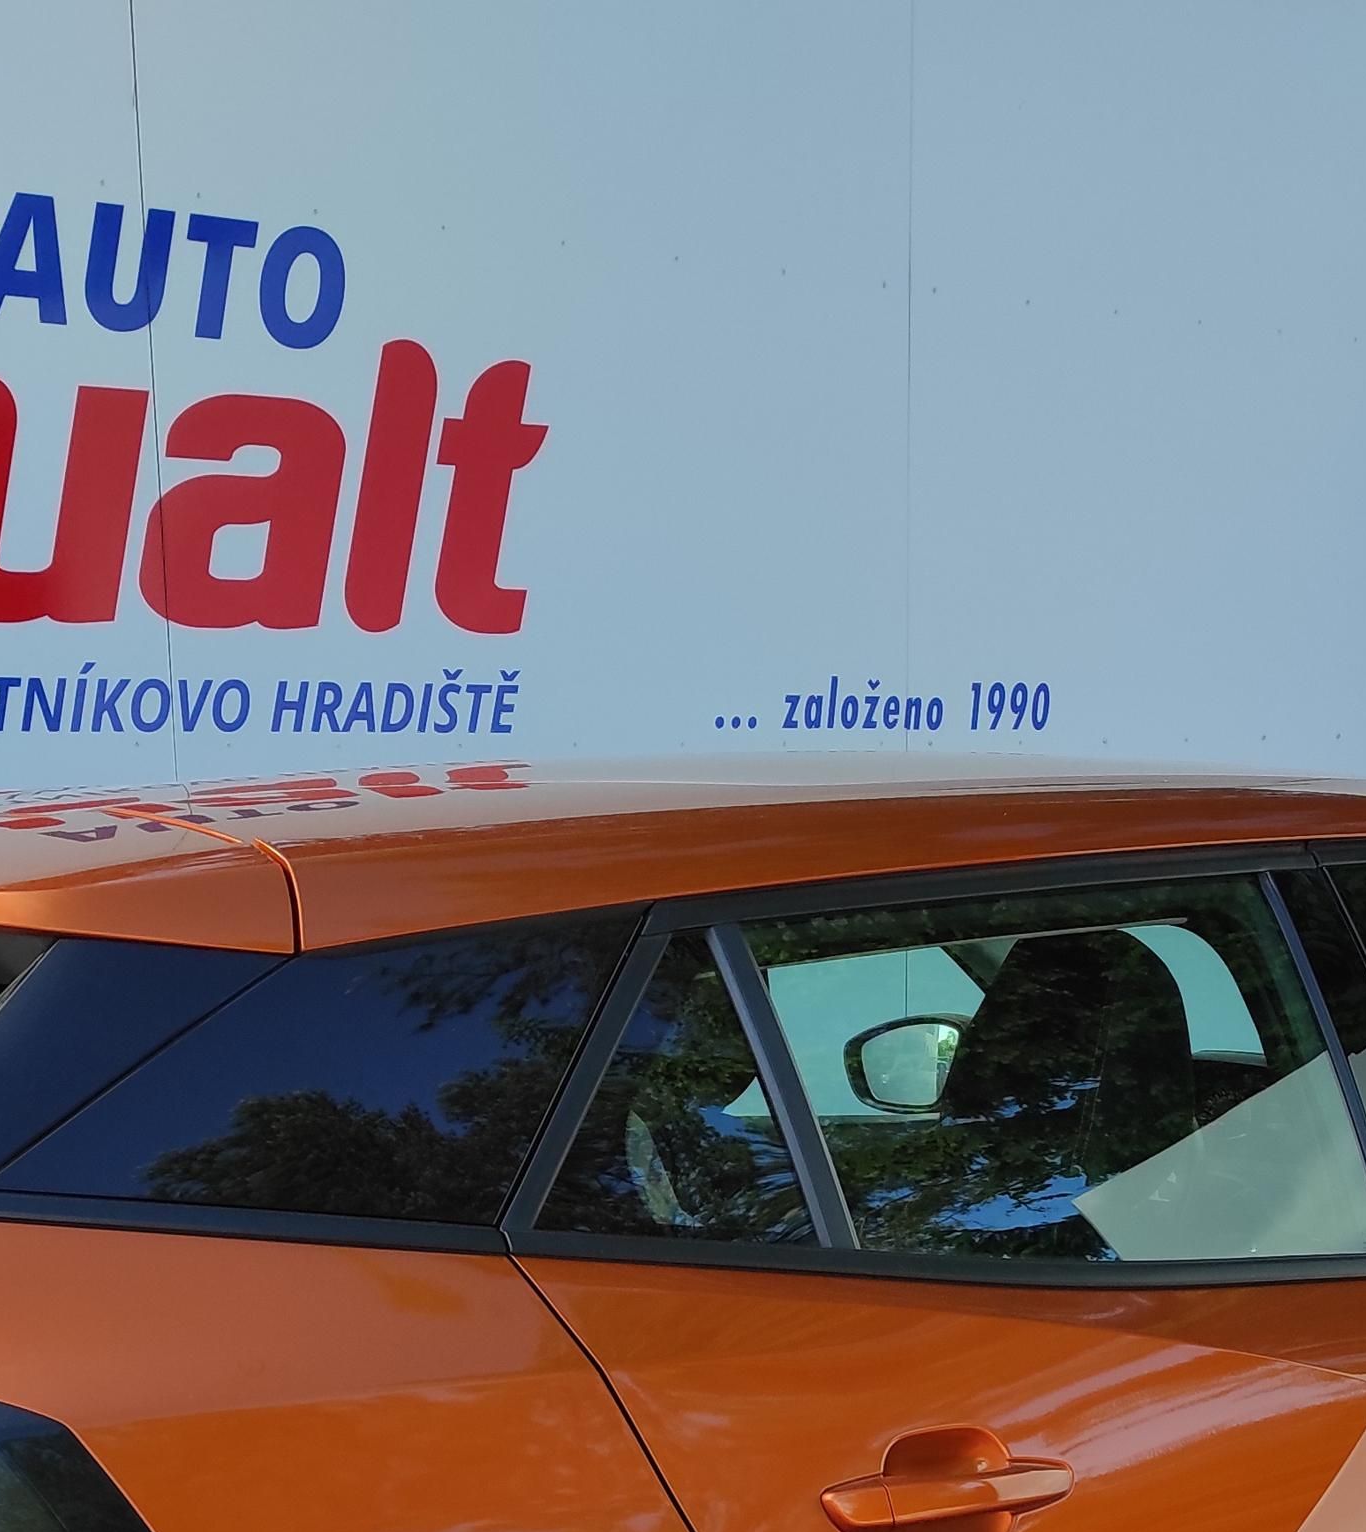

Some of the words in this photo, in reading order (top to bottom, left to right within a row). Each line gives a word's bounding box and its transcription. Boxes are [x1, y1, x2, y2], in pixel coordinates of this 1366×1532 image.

[270, 668, 520, 734] HRADIŠTĚ
[782, 675, 944, 731] založeno
[970, 682, 1051, 731] 1990
